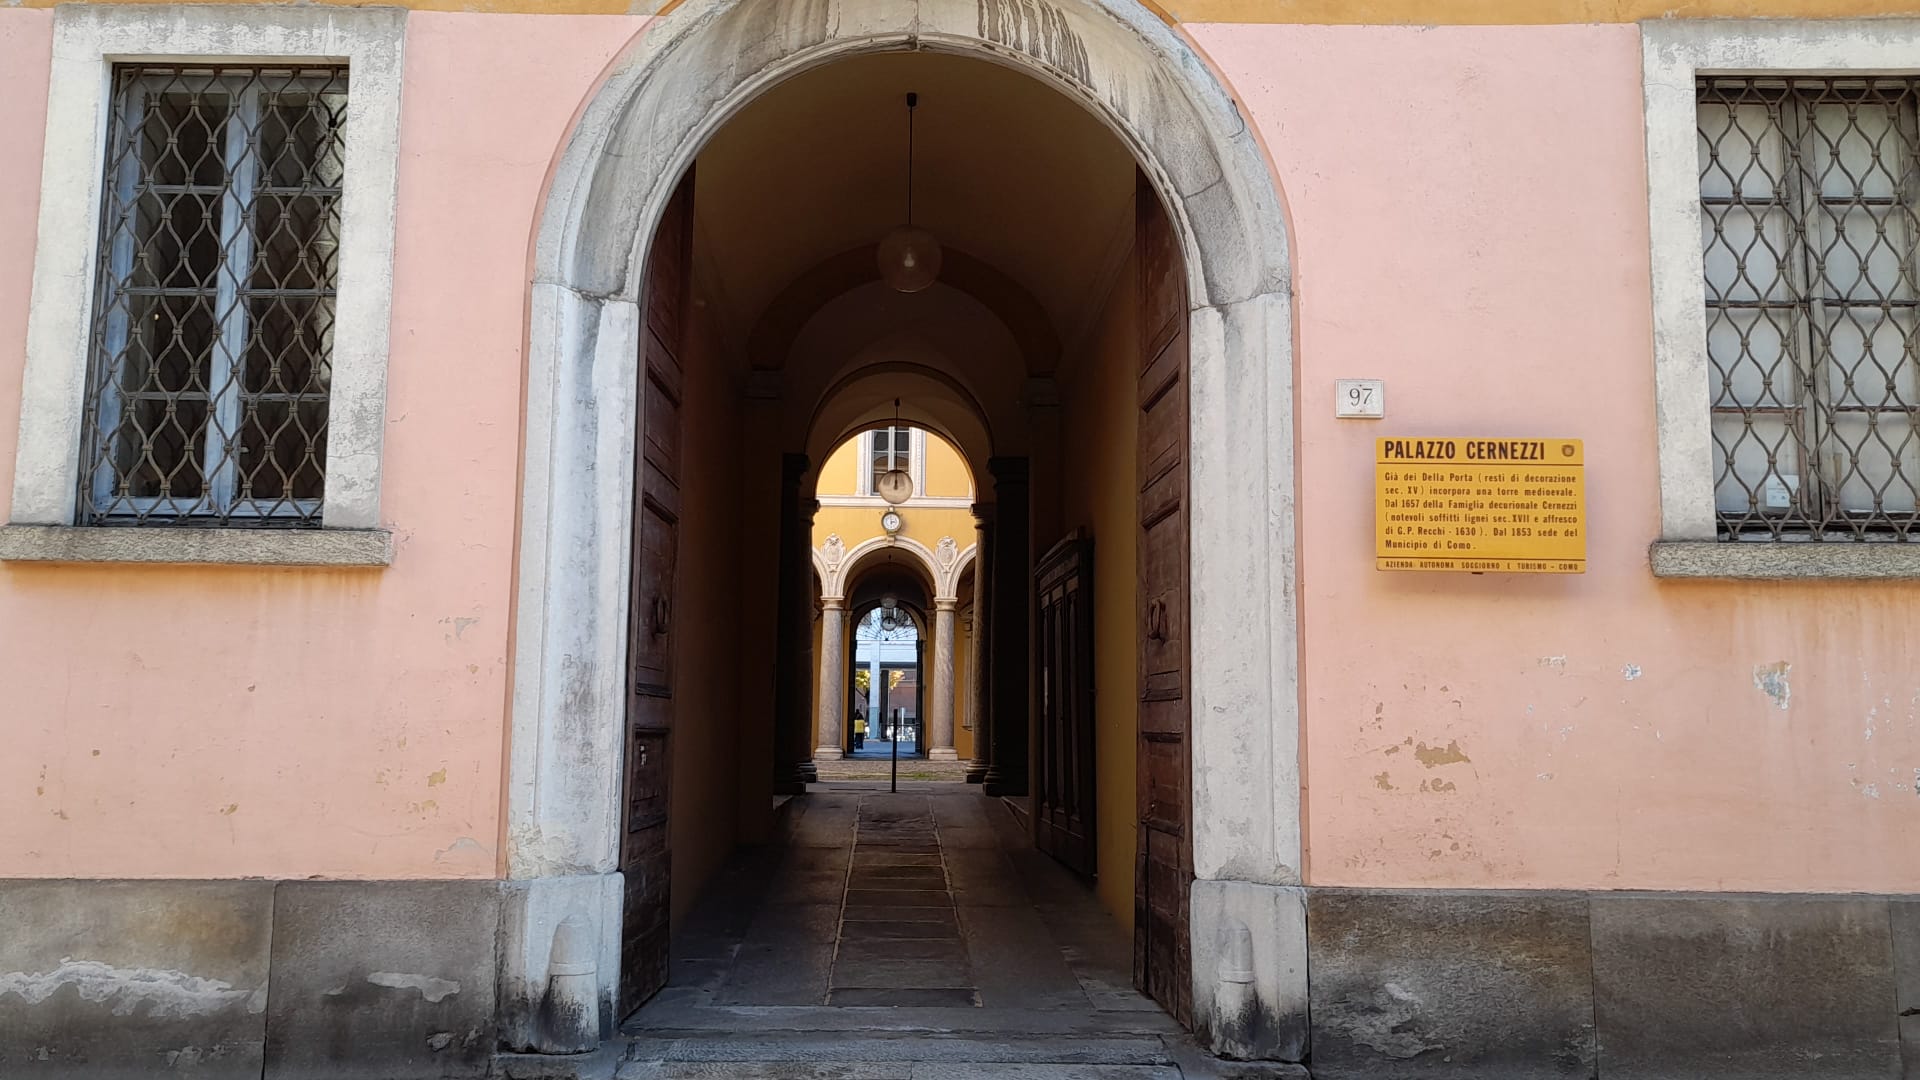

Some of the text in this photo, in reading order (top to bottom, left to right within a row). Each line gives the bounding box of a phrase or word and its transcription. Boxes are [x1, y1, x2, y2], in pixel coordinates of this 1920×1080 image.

[1349, 388, 1373, 407] 97
[1385, 441, 1544, 460] PALAZZO CERNEZZI
[1385, 472, 1398, 481] Già
[1404, 473, 1417, 481] dei
[1422, 473, 1444, 481] Della
[1450, 473, 1472, 481] Porta
[1511, 474, 1519, 482] di
[1525, 474, 1576, 483] decorazione
[1429, 486, 1470, 496] incorpora
[1524, 488, 1576, 496] medioevale.
[1385, 499, 1397, 507] Dal
[1402, 499, 1420, 508] 1657
[1423, 499, 1443, 508] della
[1449, 500, 1484, 511] Famiglia
[1489, 501, 1538, 509] decurionale
[1429, 514, 1459, 522] soffitti
[1465, 514, 1488, 524] lignei
[1543, 515, 1577, 523] affresco
[1385, 526, 1393, 535] di
[1398, 527, 1414, 535] G.P.
[1418, 527, 1445, 535] Recchi
[1494, 528, 1507, 536] Dal
[1512, 528, 1531, 536] 1853
[1538, 528, 1558, 536] sede
[1564, 529, 1578, 537] del
[1385, 540, 1427, 550] Municipio
[1447, 541, 1477, 549] Como.
